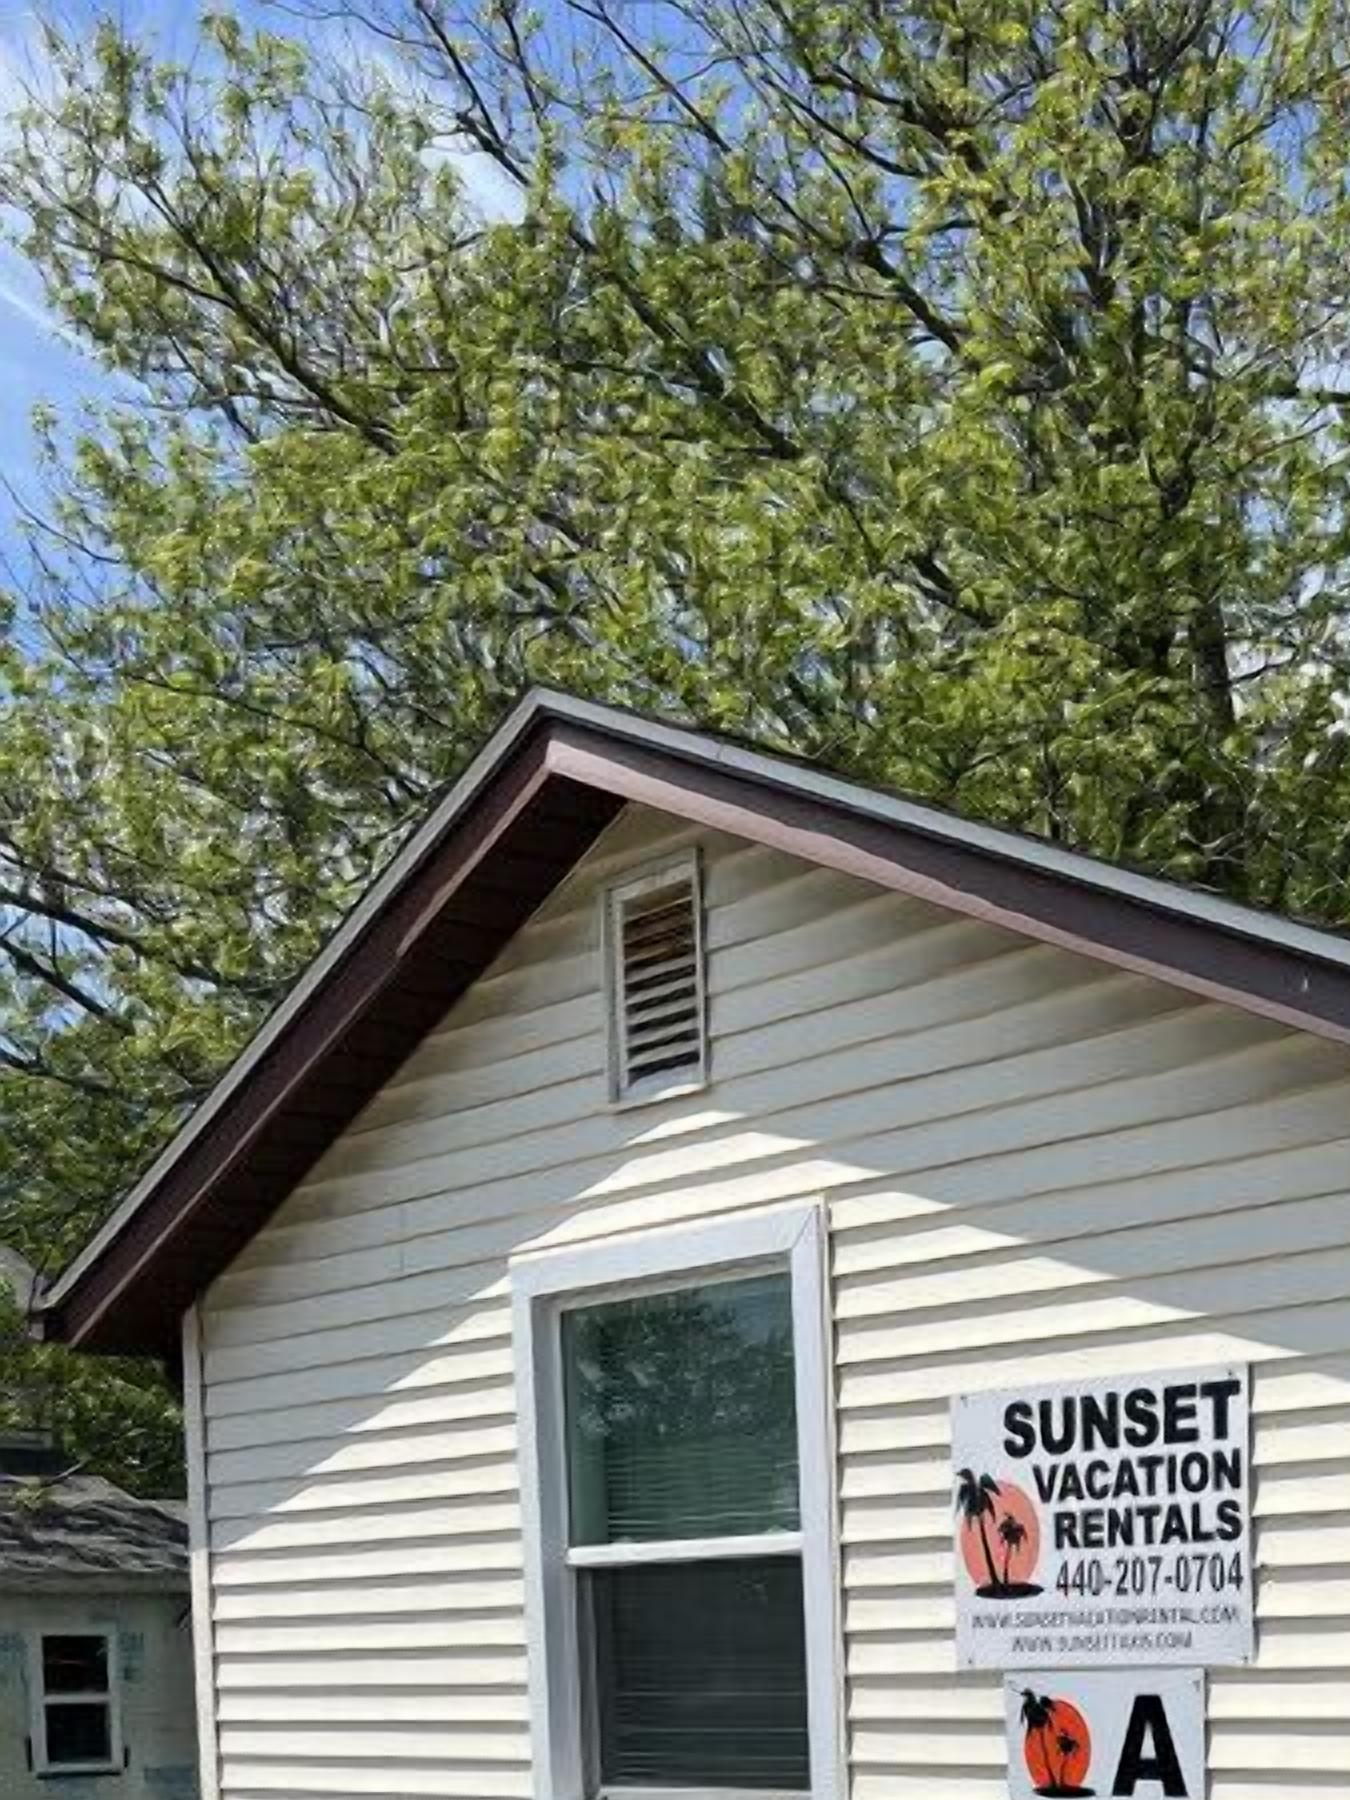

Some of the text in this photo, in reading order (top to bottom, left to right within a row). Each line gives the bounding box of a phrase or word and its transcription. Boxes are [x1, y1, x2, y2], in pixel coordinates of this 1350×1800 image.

[1003, 1379, 1241, 1459] SUNSET
[1032, 1448, 1242, 1503] VACATION
[1053, 1499, 1243, 1550] RENTALS
[1055, 1551, 1244, 1597] 440-207-0704
[1111, 1694, 1189, 1797] A
